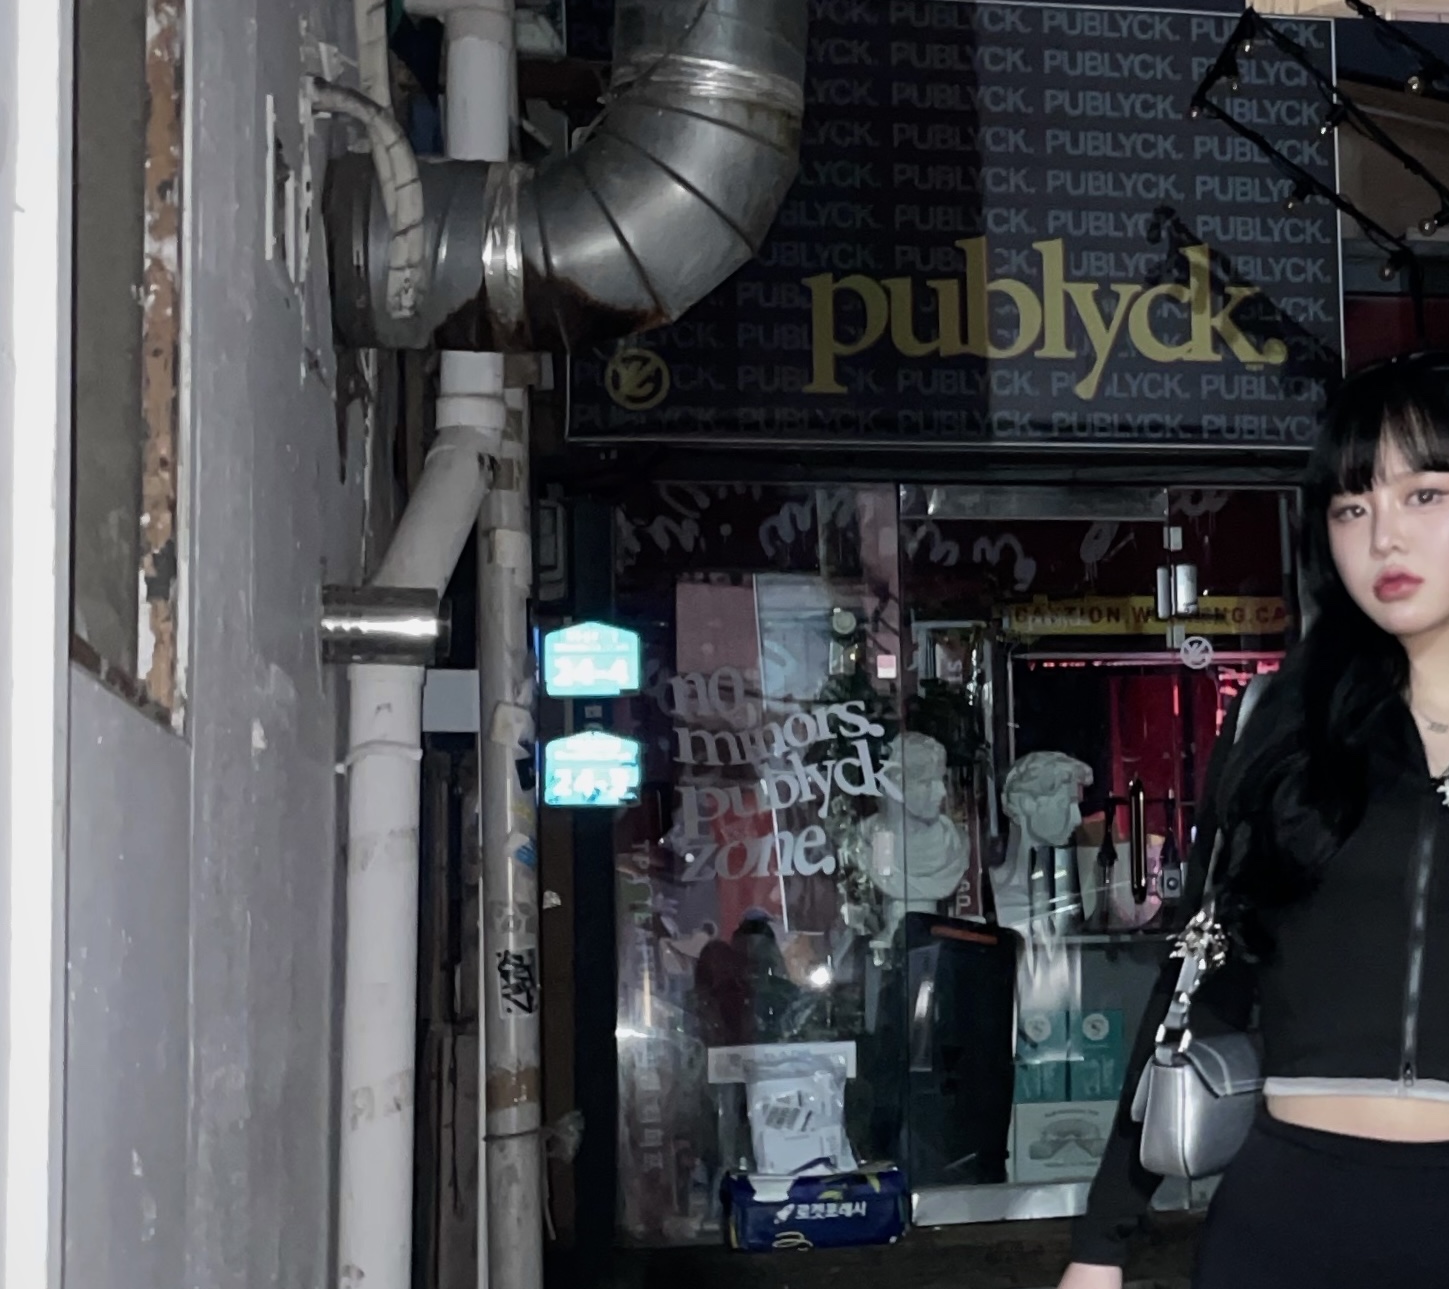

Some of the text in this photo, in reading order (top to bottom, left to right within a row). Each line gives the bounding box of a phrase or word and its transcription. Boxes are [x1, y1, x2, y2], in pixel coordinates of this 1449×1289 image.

[1042, 9, 1180, 42] PUBLYCK.
[890, 40, 1033, 74] PUBLYCK.
[1043, 49, 1182, 81] PUBLYCK.
[891, 80, 1034, 114] PUBLYCK.
[1043, 88, 1184, 121] PUBLYCK.
[892, 122, 1035, 155] PUBLYCK.
[1045, 128, 1184, 161] PUBLYCK.
[893, 162, 1036, 195] PUBLYCK.
[1046, 169, 1186, 202] PUBLYCK.
[894, 203, 1037, 235] PUBLYCK.
[1196, 214, 1332, 244] PUBLYCK.
[801, 234, 1290, 402] publyck.
[896, 366, 1040, 397] PUBLYCK.
[673, 699, 885, 766] minors.
[675, 739, 905, 839] publyck
[682, 824, 837, 883] zone.
